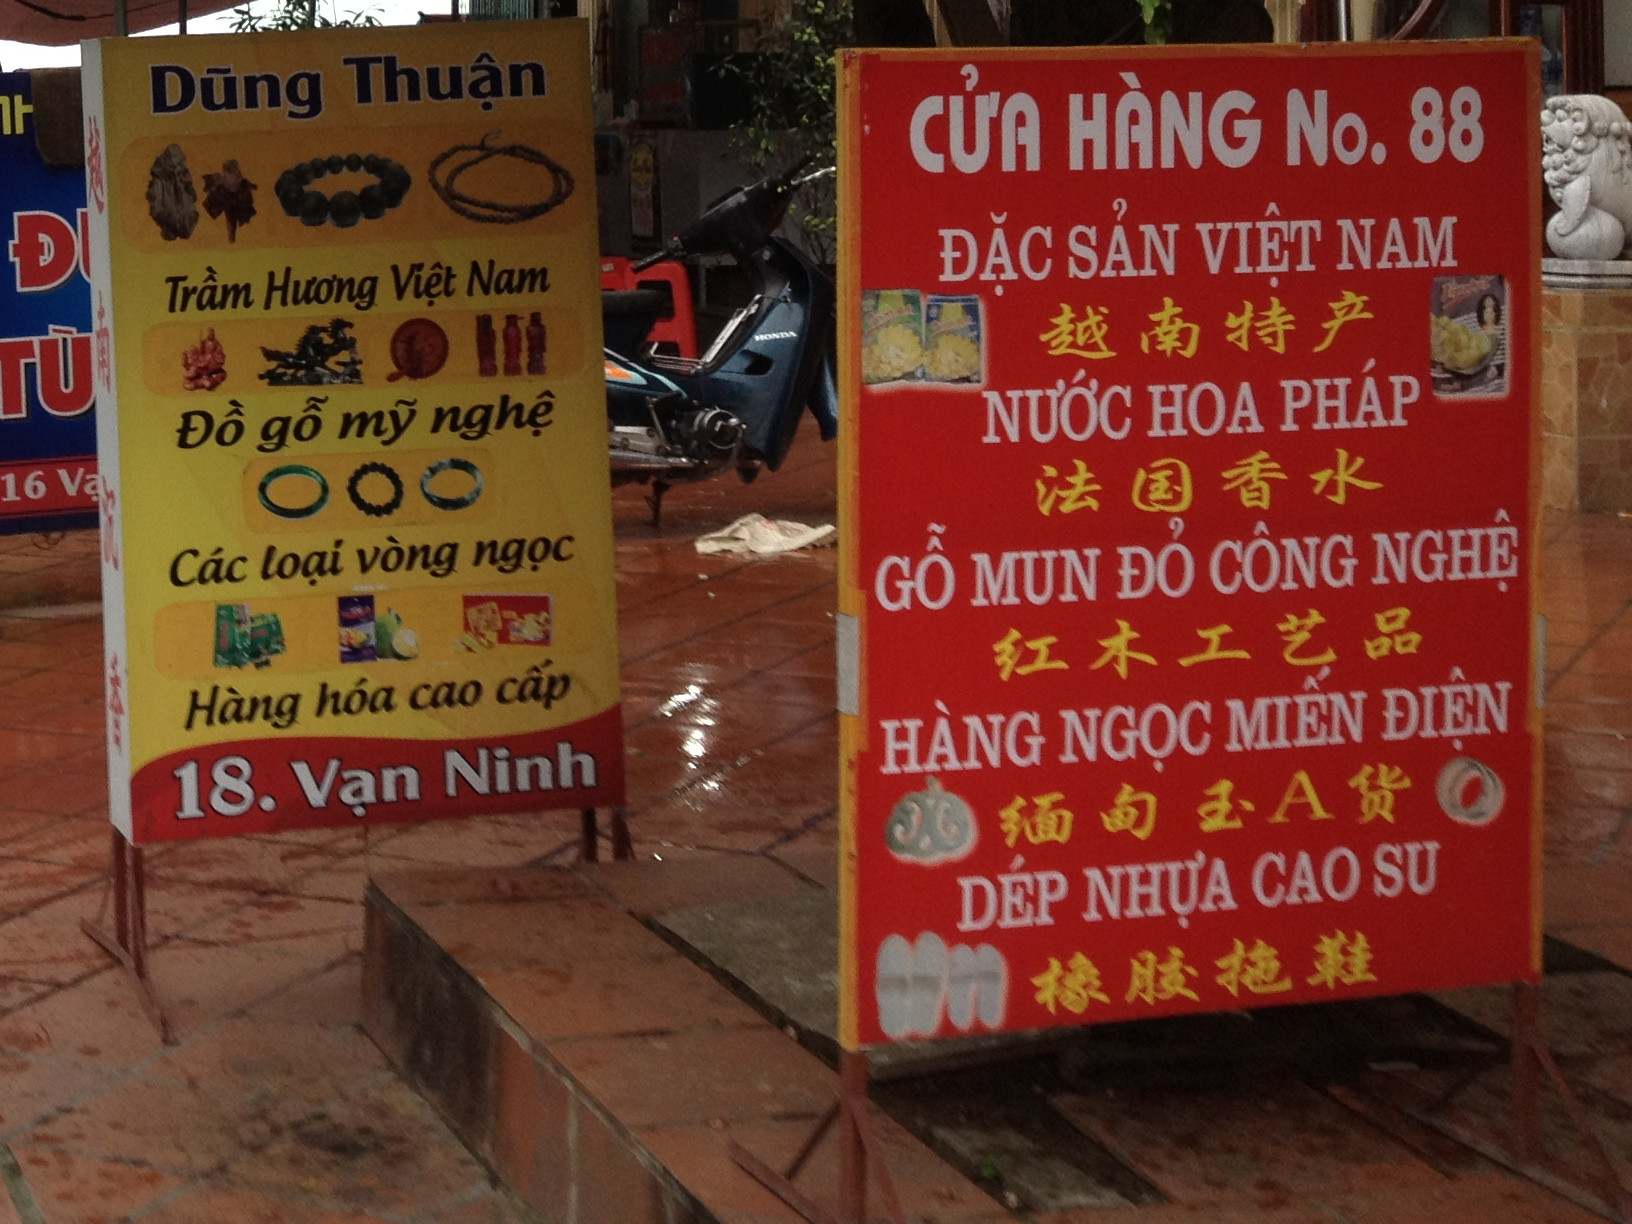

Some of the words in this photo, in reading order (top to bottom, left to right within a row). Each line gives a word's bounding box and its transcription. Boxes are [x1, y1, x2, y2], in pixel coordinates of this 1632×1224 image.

[150, 63, 323, 120] Dũng
[342, 52, 547, 112] Thuận
[910, 65, 1040, 173] CỬA
[1069, 72, 1261, 170] HÀNG
[1287, 88, 1386, 166] No.
[1409, 86, 1485, 164] 88
[939, 212, 1053, 296] ĐẶC
[1068, 198, 1180, 278] SẢN
[1196, 203, 1322, 287] VIỆT
[1340, 216, 1459, 270] NAM
[165, 266, 255, 313] Trầm
[263, 267, 379, 311] Hương
[391, 262, 457, 307] Việt
[467, 260, 550, 296] Nam
[755, 330, 797, 342] HONDA
[1038, 289, 1374, 360] 越南特产
[176, 400, 244, 449] Đồ
[256, 397, 330, 452] gỗ
[339, 399, 417, 440] mỹ
[421, 390, 556, 440] nghệ
[981, 369, 1133, 445] NƯỚC
[1148, 381, 1265, 437] HOA
[1281, 358, 1420, 430] PHÁP
[0, 470, 47, 502] 16
[1037, 447, 1384, 516] 法国香水
[169, 547, 248, 588] Các
[261, 539, 343, 588] loại
[357, 535, 459, 579] vòng
[472, 532, 575, 573] ngọc
[875, 523, 956, 612] GỖ
[971, 549, 1098, 607] MUN
[1117, 517, 1195, 599] ĐỎ
[1209, 520, 1355, 596] CÔNG
[1371, 508, 1520, 592] NGHỆ
[993, 606, 1423, 681] 红木工艺品
[184, 685, 299, 731] Hàng
[315, 678, 396, 718] hóa
[409, 678, 482, 711] cao
[496, 658, 573, 711] cấp
[879, 701, 1046, 774] HÀNG
[1058, 701, 1211, 773] NGỌC
[1224, 666, 1367, 754] MIẾN
[1381, 665, 1512, 754] ĐIỆN
[173, 755, 277, 821] 18.
[290, 757, 421, 818] Vạn
[443, 742, 598, 797] Ninh
[998, 762, 1412, 849] 缅甸玉A货
[956, 856, 1069, 932] DÉP
[1082, 850, 1237, 928] NHỰA
[1252, 847, 1360, 902] CAO
[1372, 840, 1440, 898] SU
[1030, 929, 1379, 1015] 橡胶拖鞋
